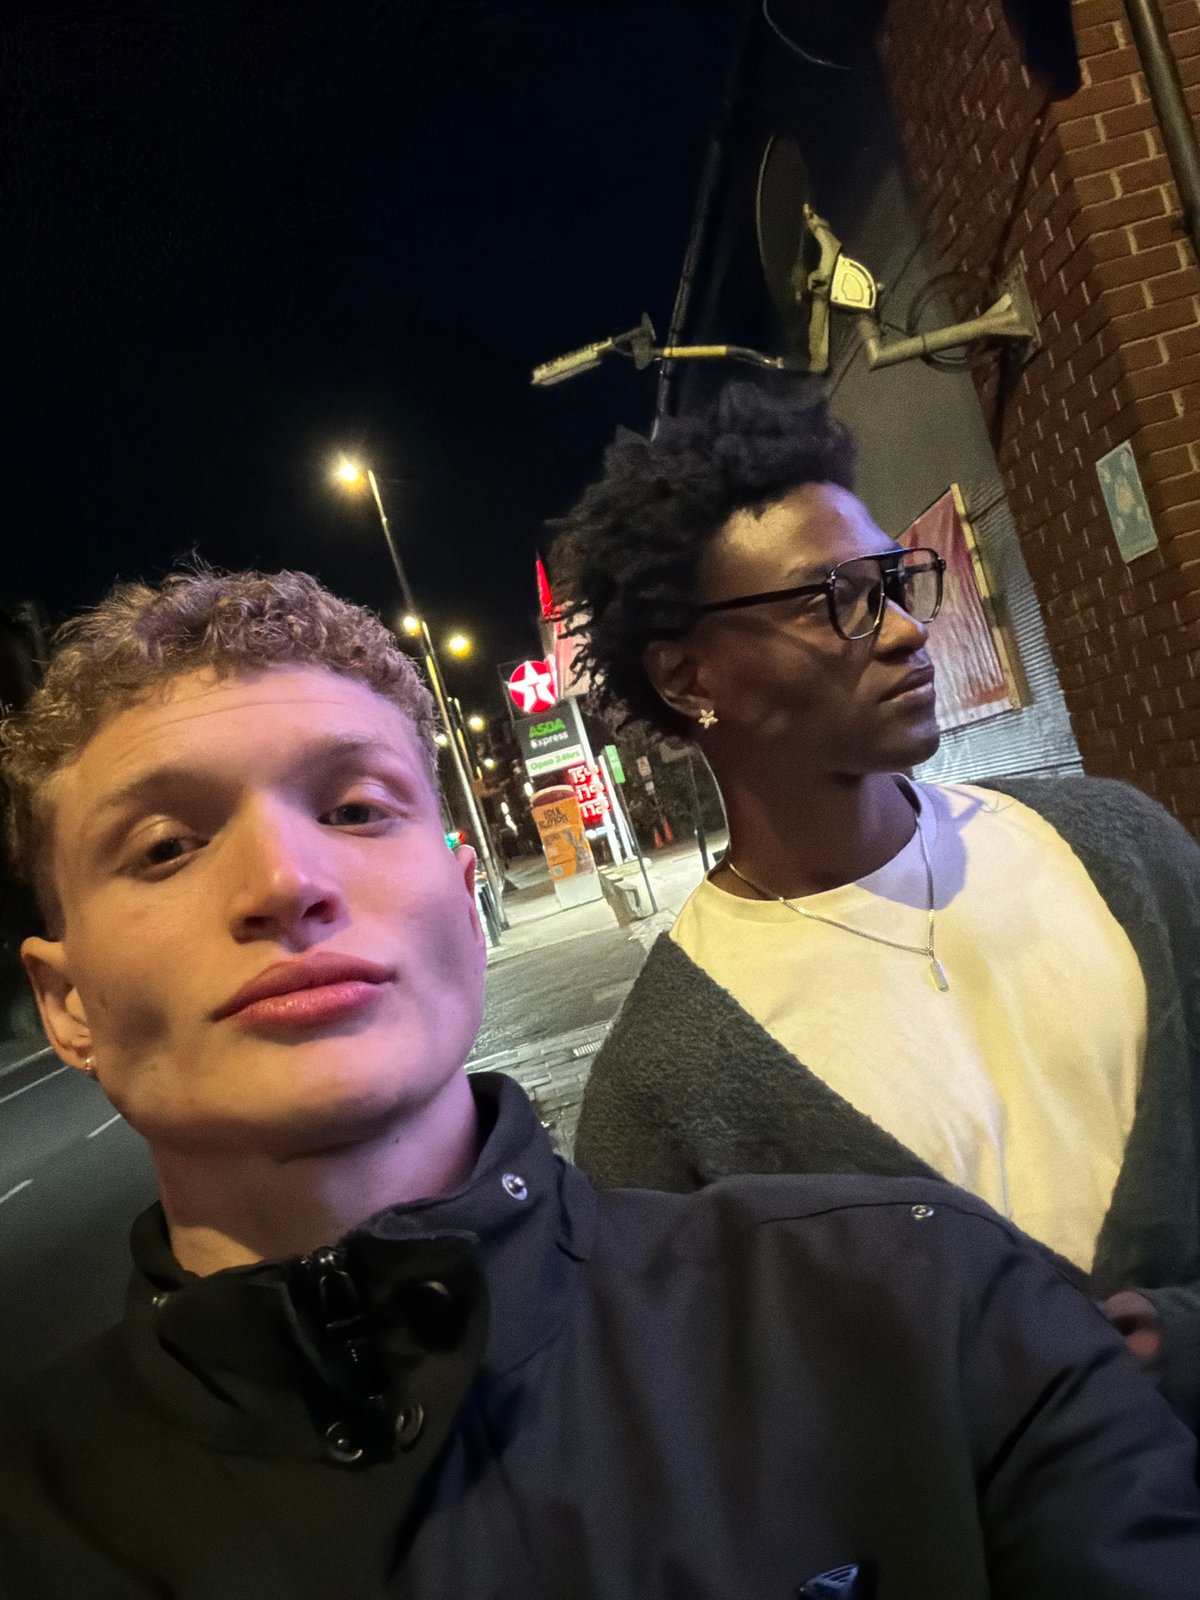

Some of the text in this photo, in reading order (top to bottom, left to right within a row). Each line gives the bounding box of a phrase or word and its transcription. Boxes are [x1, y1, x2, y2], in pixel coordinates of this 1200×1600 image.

[530, 719, 566, 737] ASDA
[531, 732, 568, 748] Express
[531, 751, 580, 770] Open 24hrs
